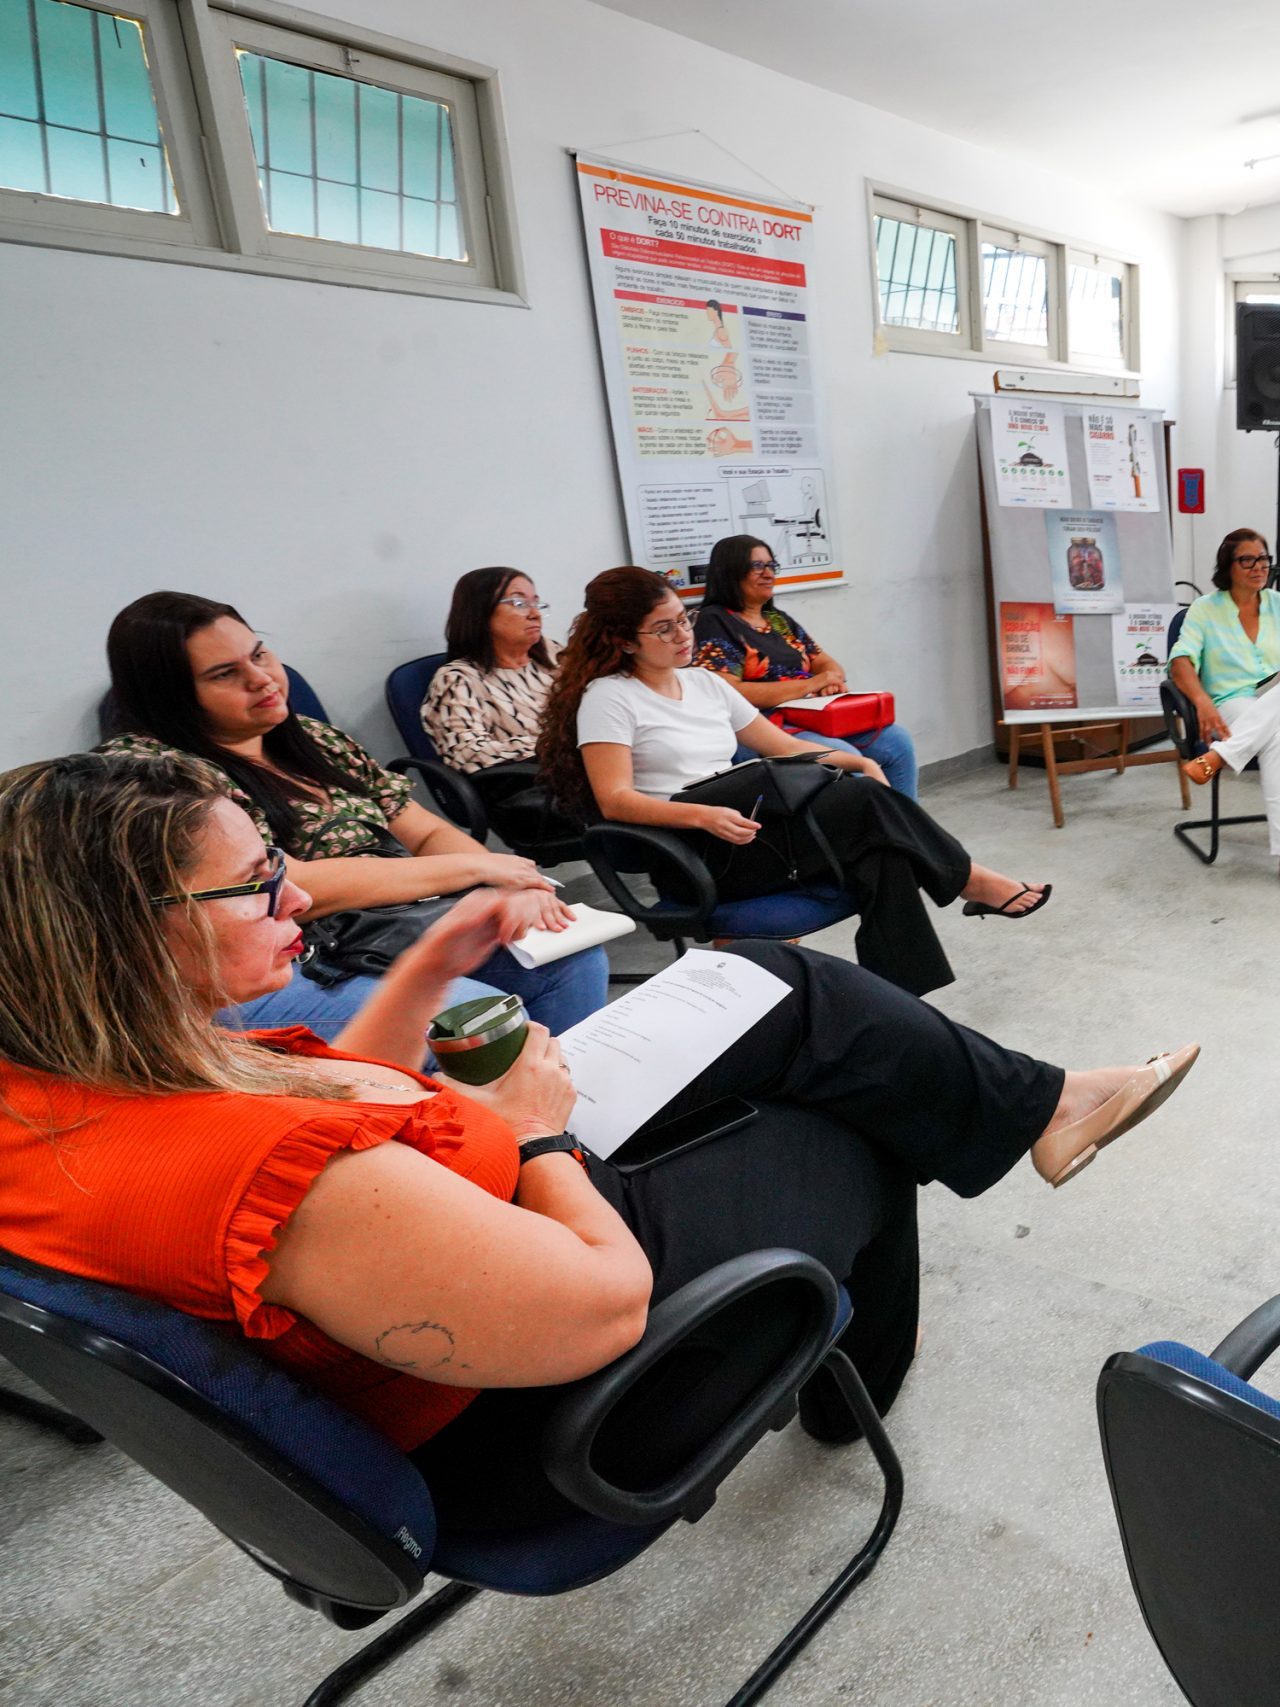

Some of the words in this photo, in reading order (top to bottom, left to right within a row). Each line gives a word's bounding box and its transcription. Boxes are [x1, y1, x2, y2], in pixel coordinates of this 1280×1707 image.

[593, 183, 693, 221] PREVINA-SE
[697, 206, 760, 234] CONTRA
[762, 219, 802, 242] DORT
[647, 215, 666, 228] Faça
[668, 219, 678, 229] 10
[680, 221, 708, 235] minutos
[711, 227, 720, 237] de
[655, 228, 673, 239] cada
[675, 230, 684, 241] 50
[686, 233, 715, 246] minutos
[635, 236, 659, 248] DORT?
[396, 1526, 423, 1559] Regma
